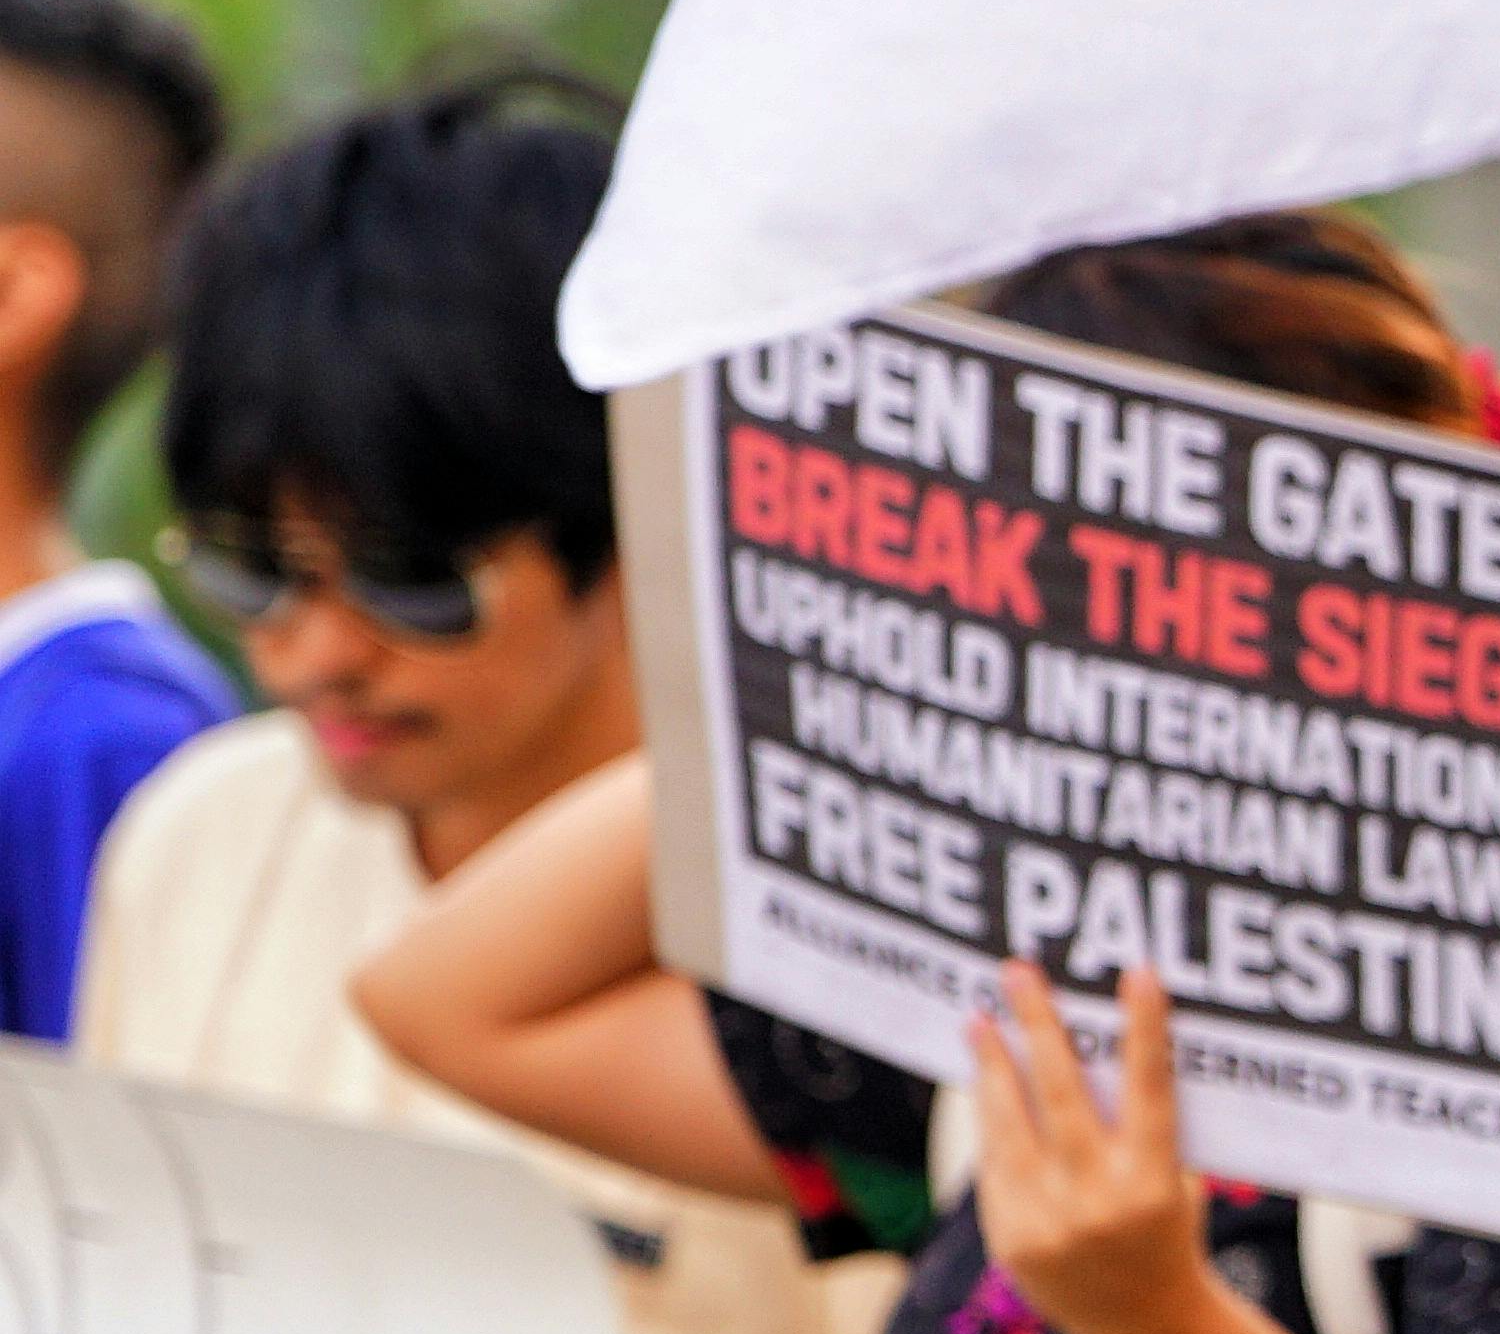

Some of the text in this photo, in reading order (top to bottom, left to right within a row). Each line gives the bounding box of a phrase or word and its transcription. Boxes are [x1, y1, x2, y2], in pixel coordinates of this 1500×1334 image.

[726, 327, 993, 482] OPEN
[1015, 371, 1226, 538] THE
[727, 422, 1045, 629] BREAK
[1069, 521, 1274, 680] THE
[732, 545, 1012, 720] UPHOLD
[749, 737, 987, 939] FREE
[789, 660, 1345, 896] HUMANITARIAN
